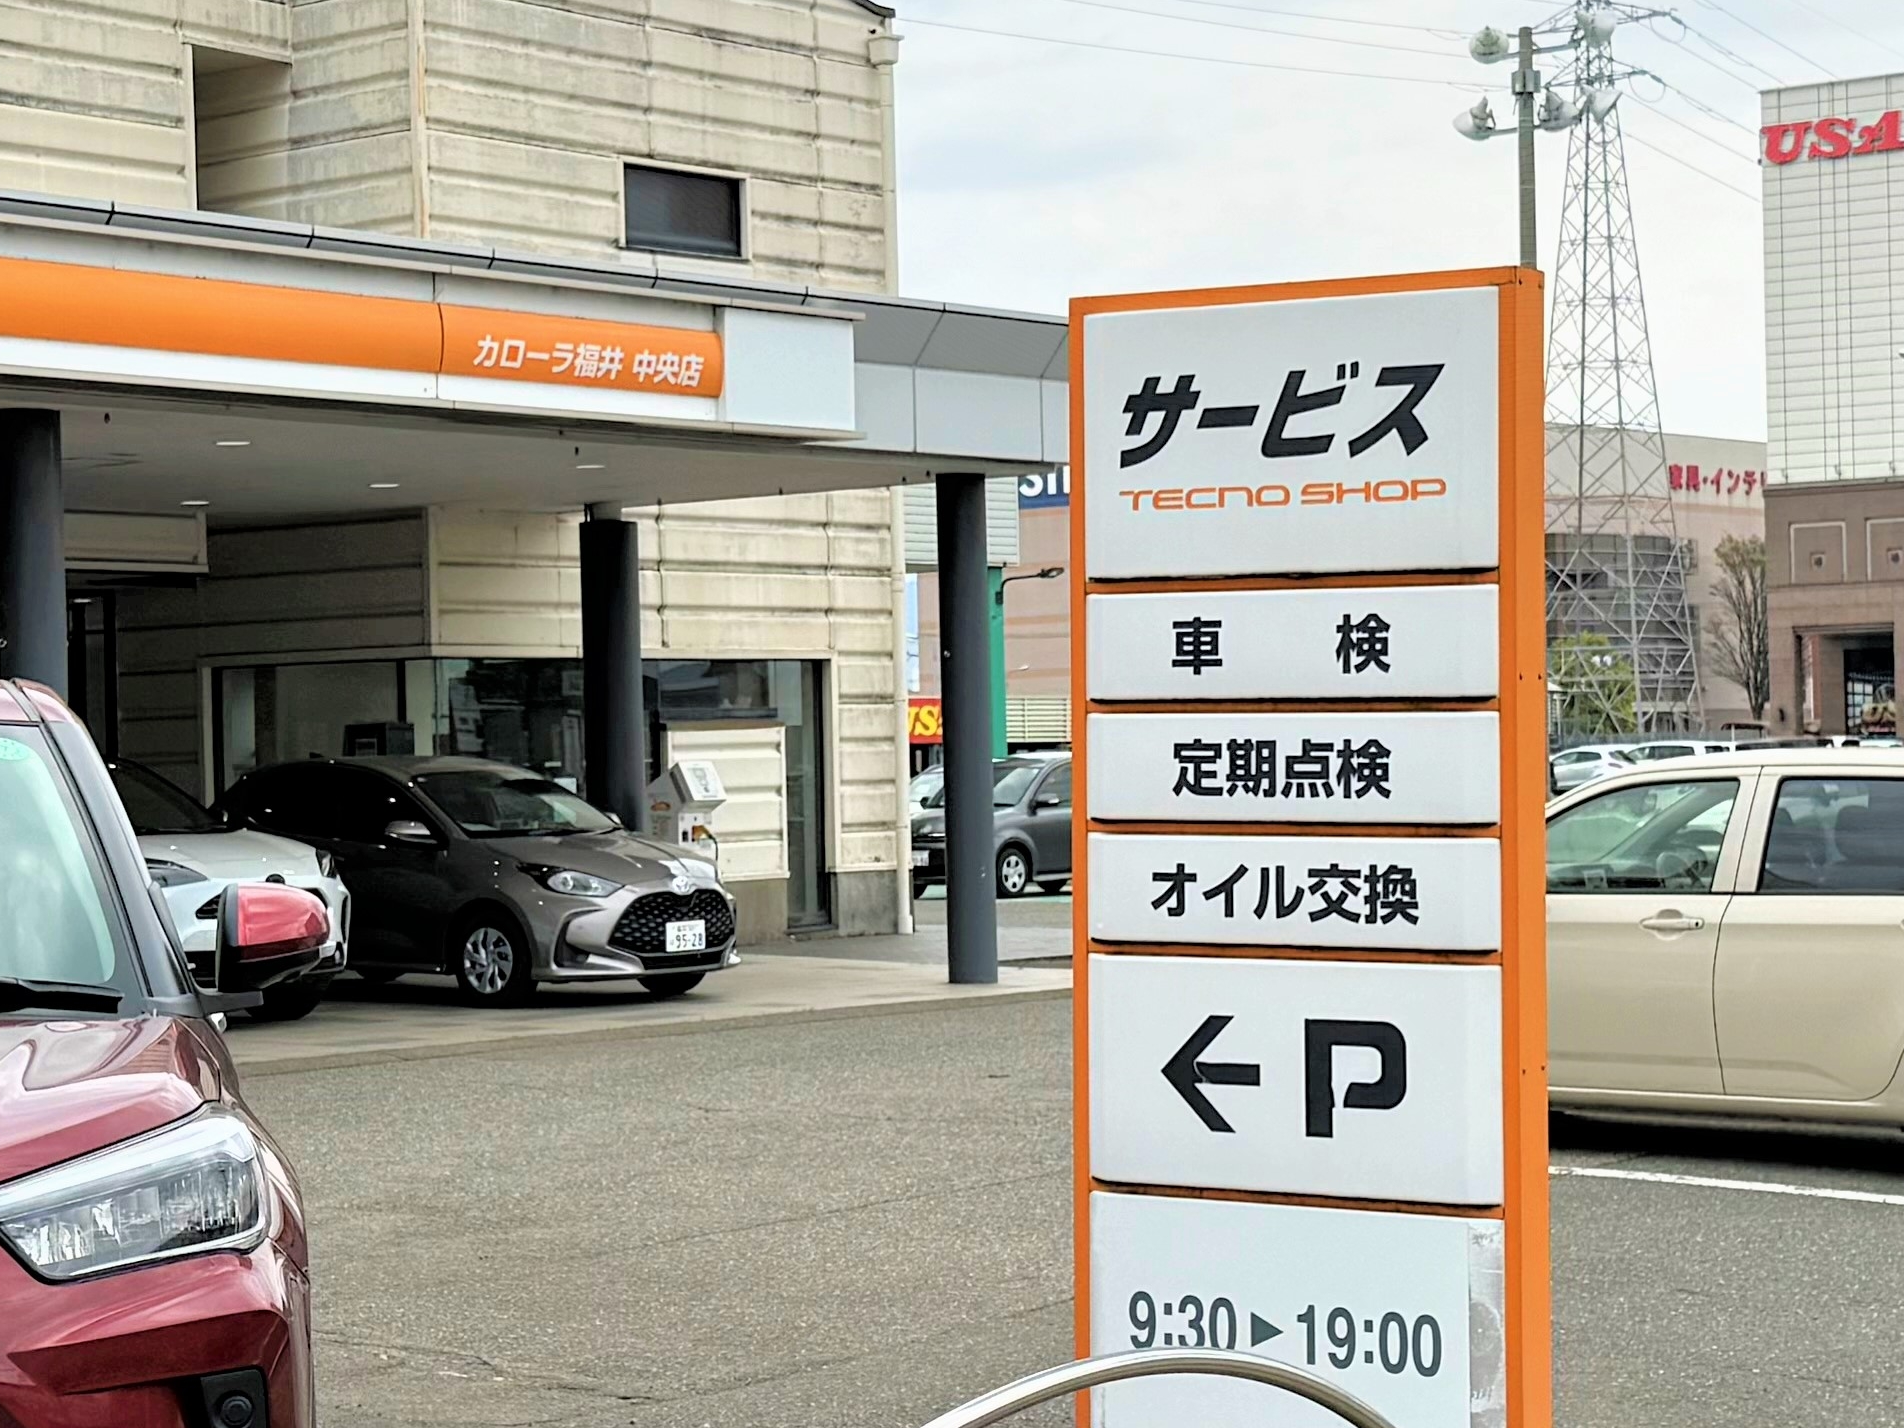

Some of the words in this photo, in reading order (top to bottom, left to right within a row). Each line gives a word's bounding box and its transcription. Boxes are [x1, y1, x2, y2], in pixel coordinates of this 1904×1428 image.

[472, 333, 623, 380] カローラ福井
[631, 348, 704, 387] 中央店
[1119, 360, 1445, 469] サービス
[1119, 484, 1291, 511] TECNO
[1300, 477, 1446, 504] SHOP
[1172, 738, 1392, 799] 定期点検
[1151, 863, 1419, 925] オイル交換
[675, 933, 703, 949] 95-28
[1304, 1018, 1407, 1138] P
[1128, 1290, 1237, 1350] 9:30
[1296, 1304, 1442, 1377] 19:00
